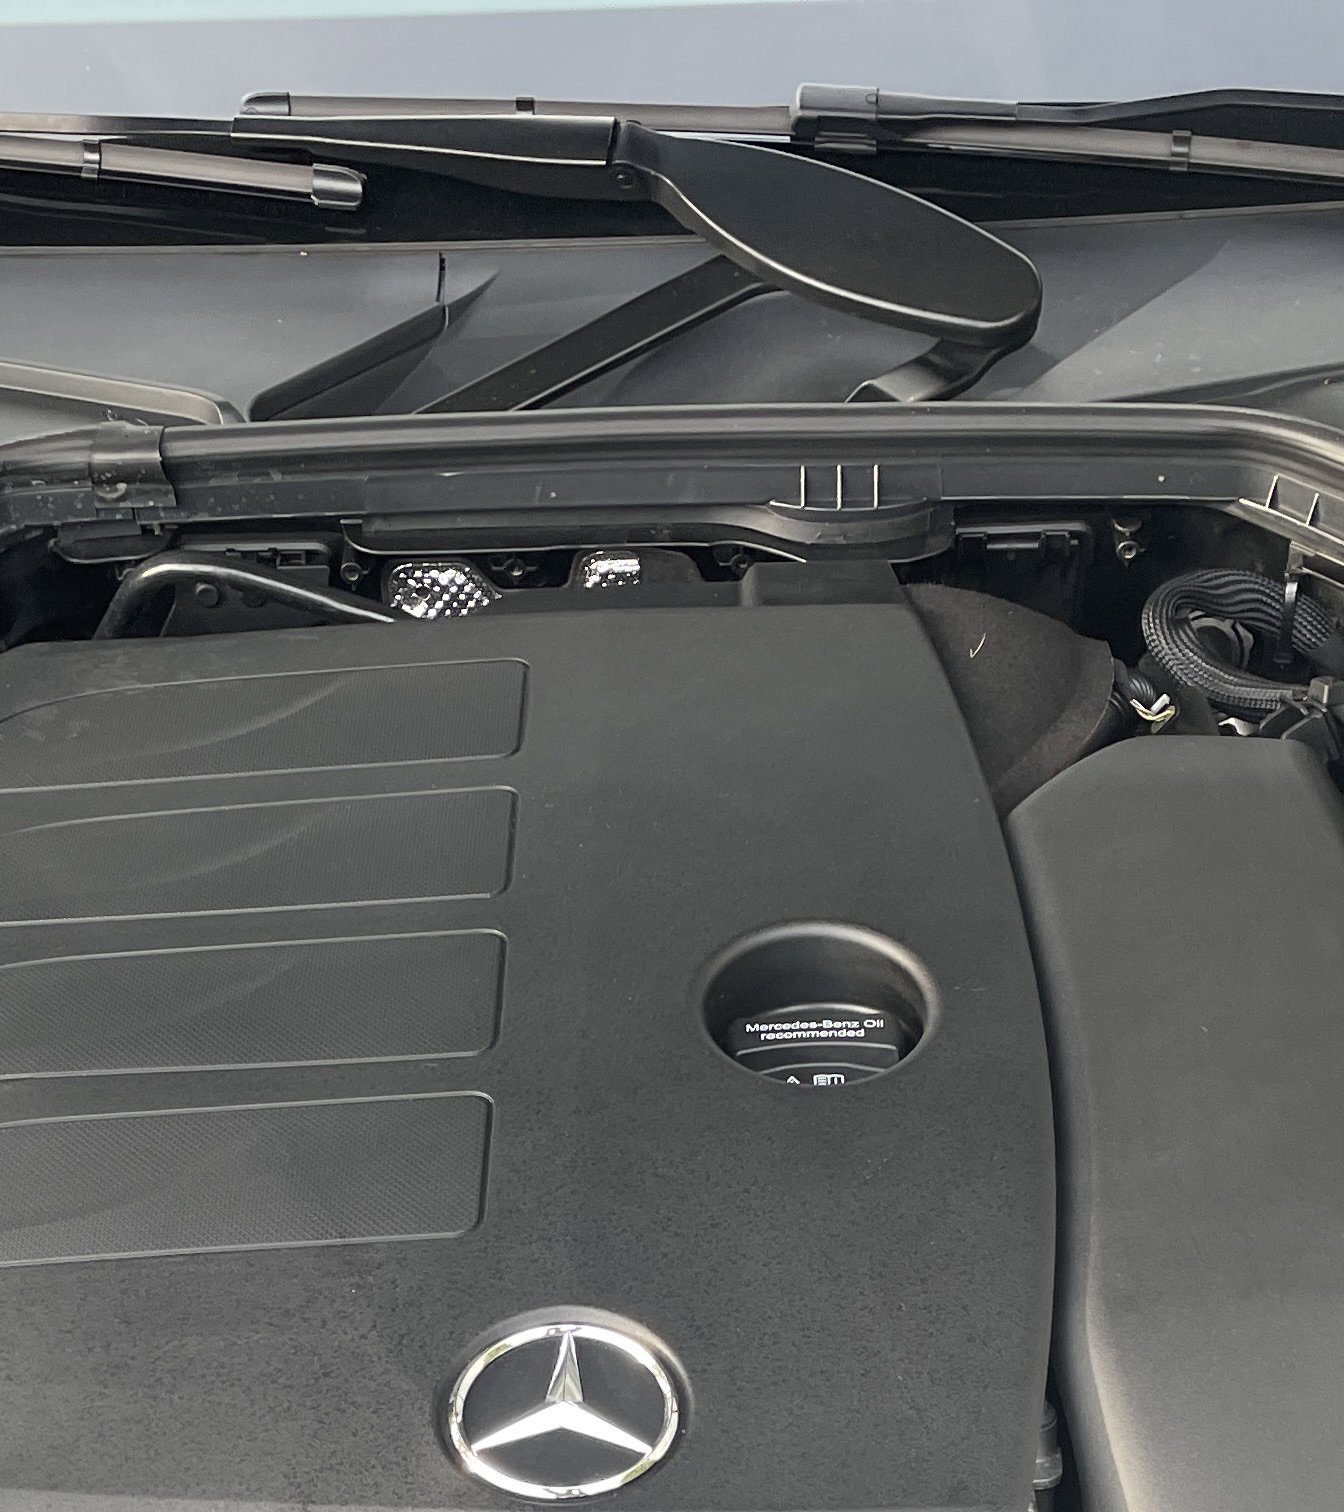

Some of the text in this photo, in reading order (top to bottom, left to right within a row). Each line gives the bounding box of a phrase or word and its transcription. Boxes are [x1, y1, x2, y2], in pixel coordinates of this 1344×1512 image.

[745, 1019, 884, 1033] Mercedes-Benz Oil
[760, 1029, 865, 1041] recommended
